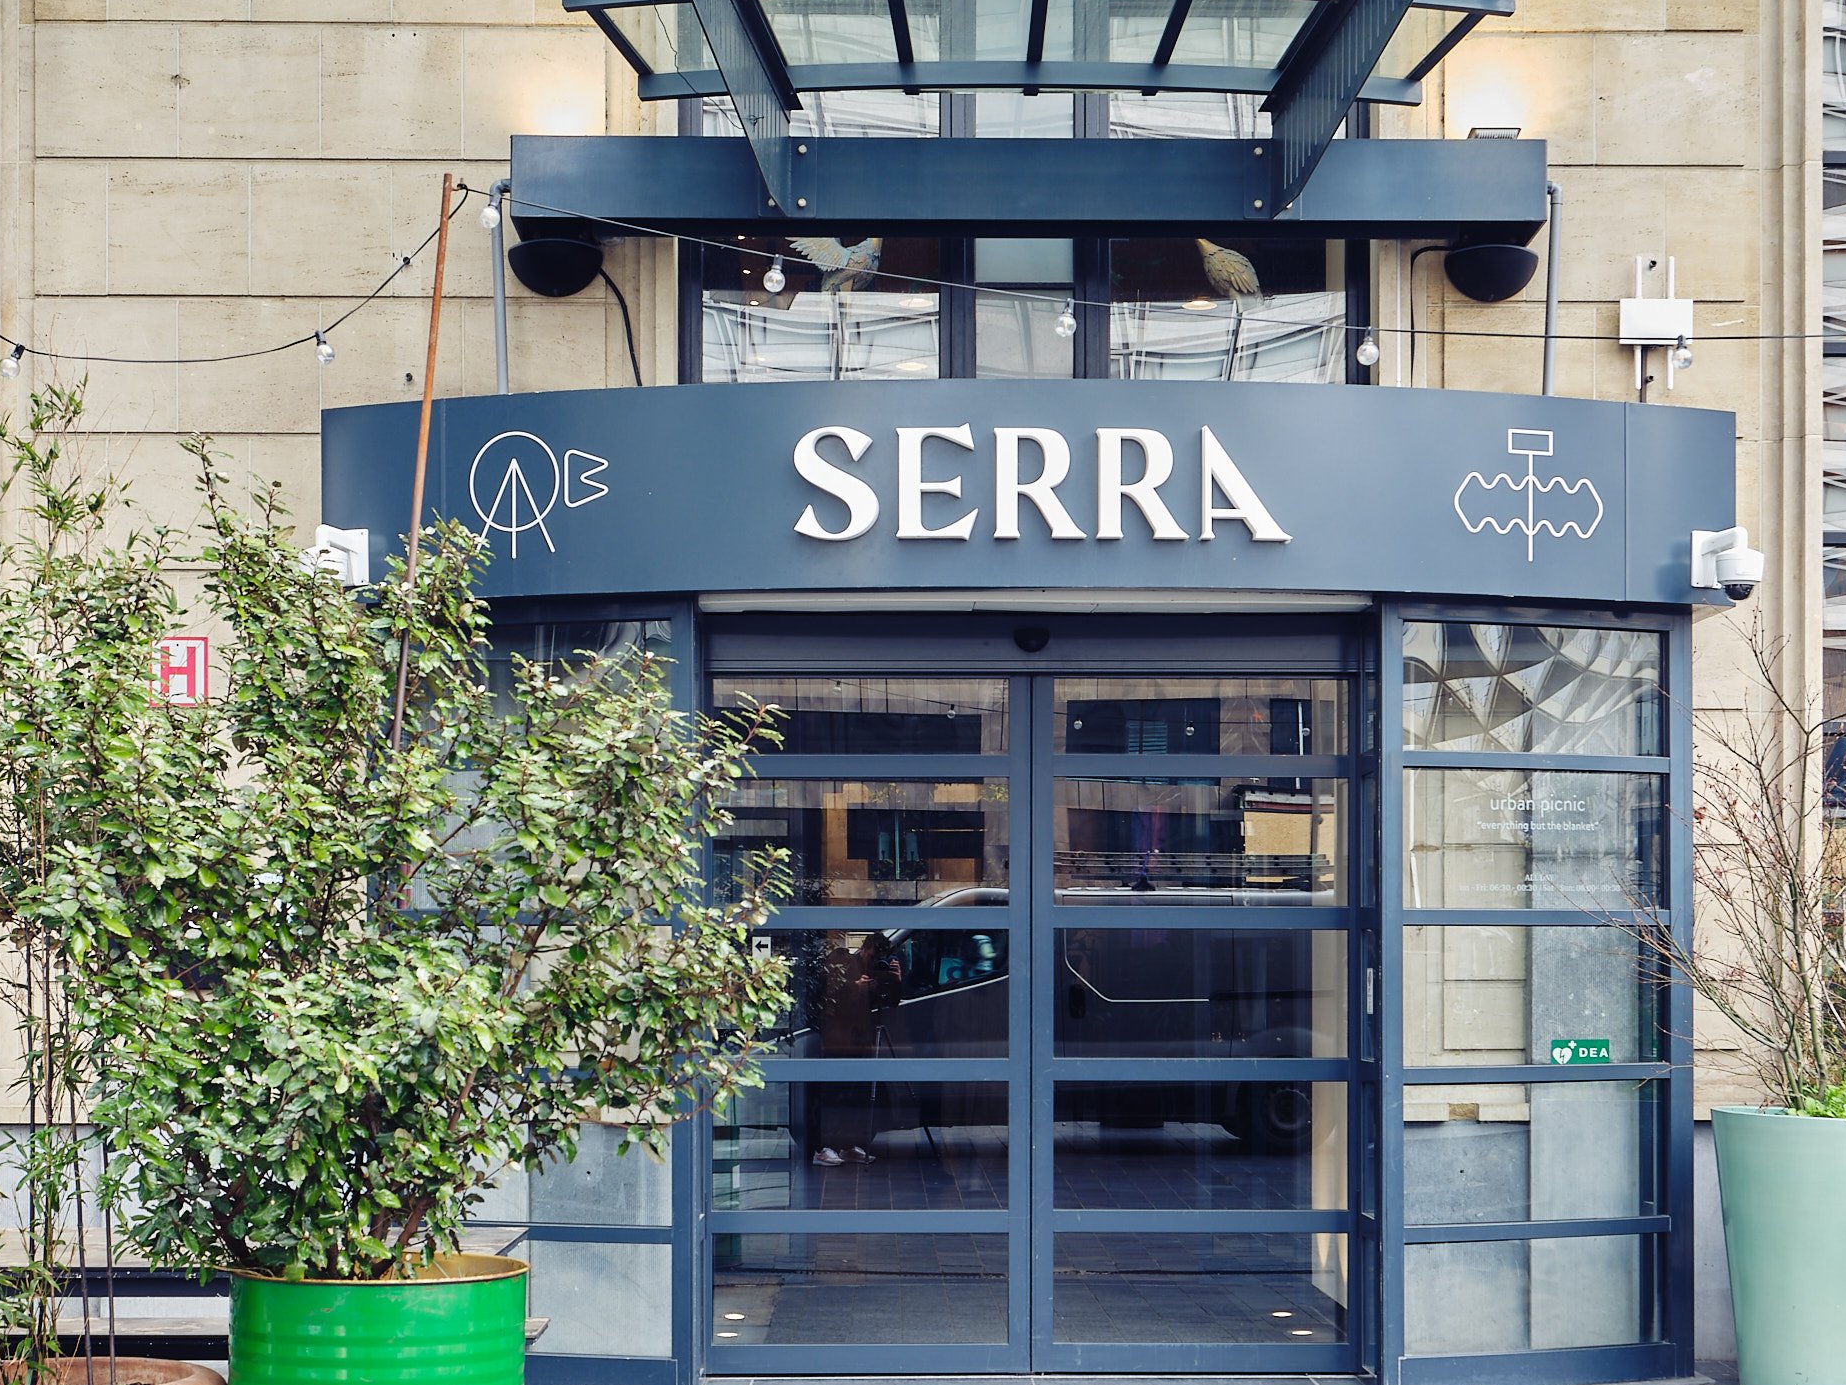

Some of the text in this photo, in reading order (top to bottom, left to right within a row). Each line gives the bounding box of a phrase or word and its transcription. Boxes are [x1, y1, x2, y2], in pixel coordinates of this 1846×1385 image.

[793, 423, 1293, 543] SERRA
[161, 646, 196, 697] H
[1490, 793, 1586, 817] urban picnic
[1531, 821, 1546, 830] but
[1547, 821, 1562, 831] the
[1578, 1047, 1608, 1058] DEA
